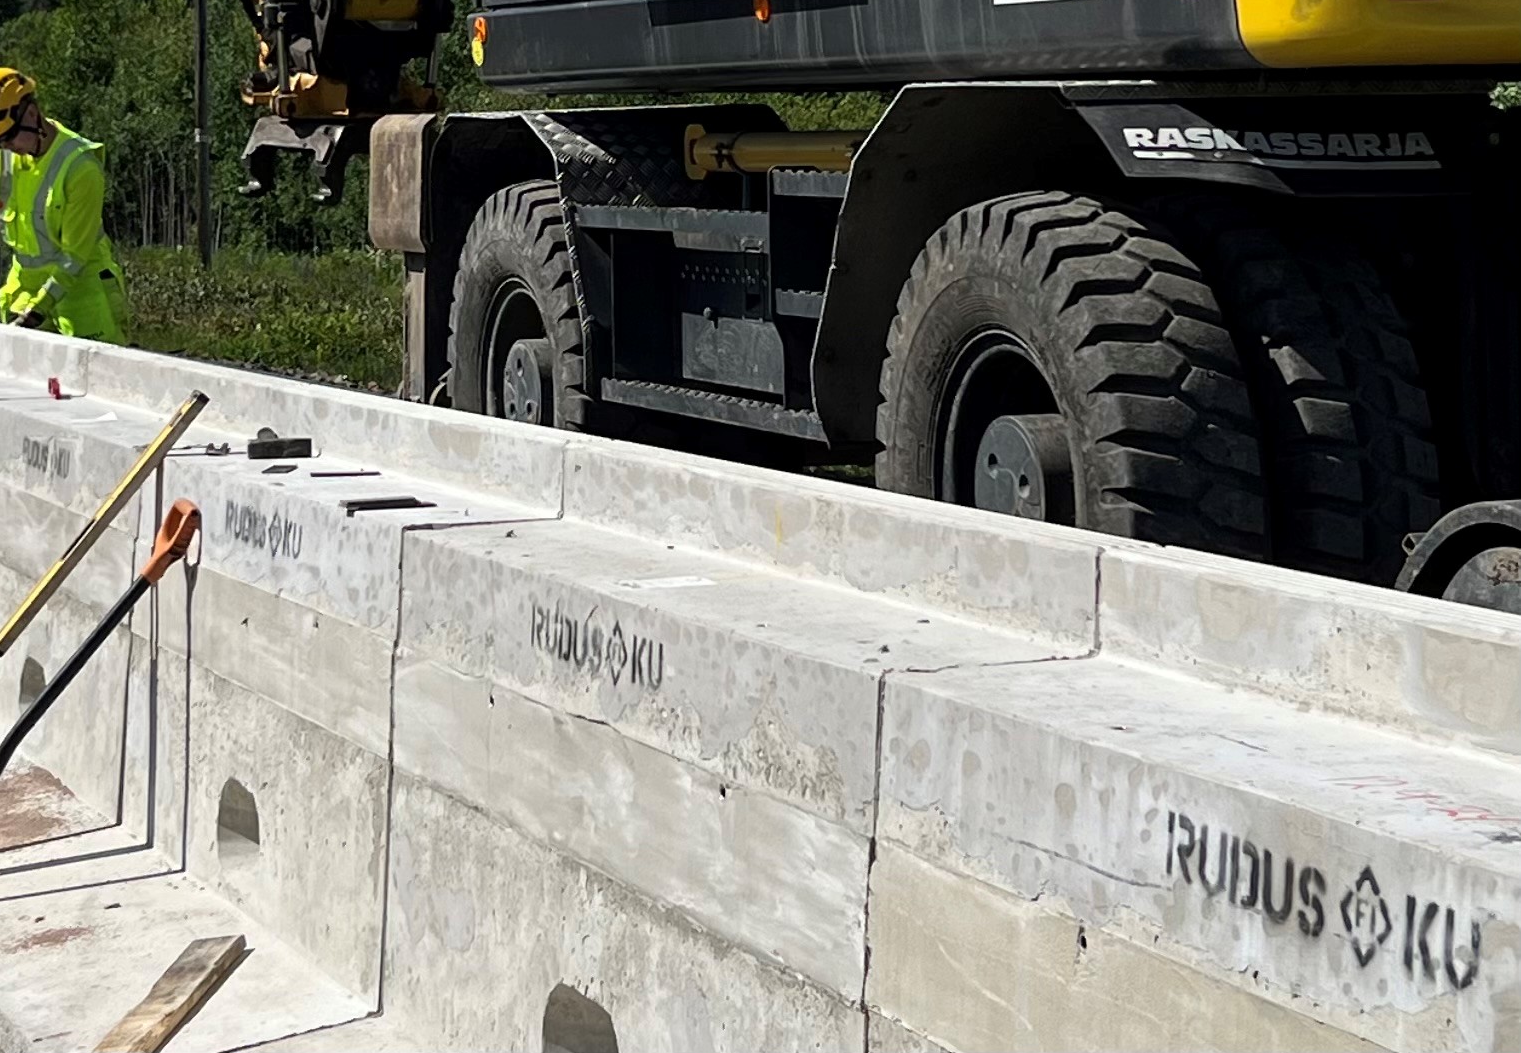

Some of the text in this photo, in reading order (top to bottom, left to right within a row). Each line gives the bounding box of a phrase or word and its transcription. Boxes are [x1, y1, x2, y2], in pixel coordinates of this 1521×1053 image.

[1123, 127, 1435, 157] RASKASSARJA
[282, 518, 304, 560] KU
[531, 603, 664, 691] RUDUS KU
[1165, 810, 1327, 938] RUDUS
[1402, 894, 1482, 990] KU
